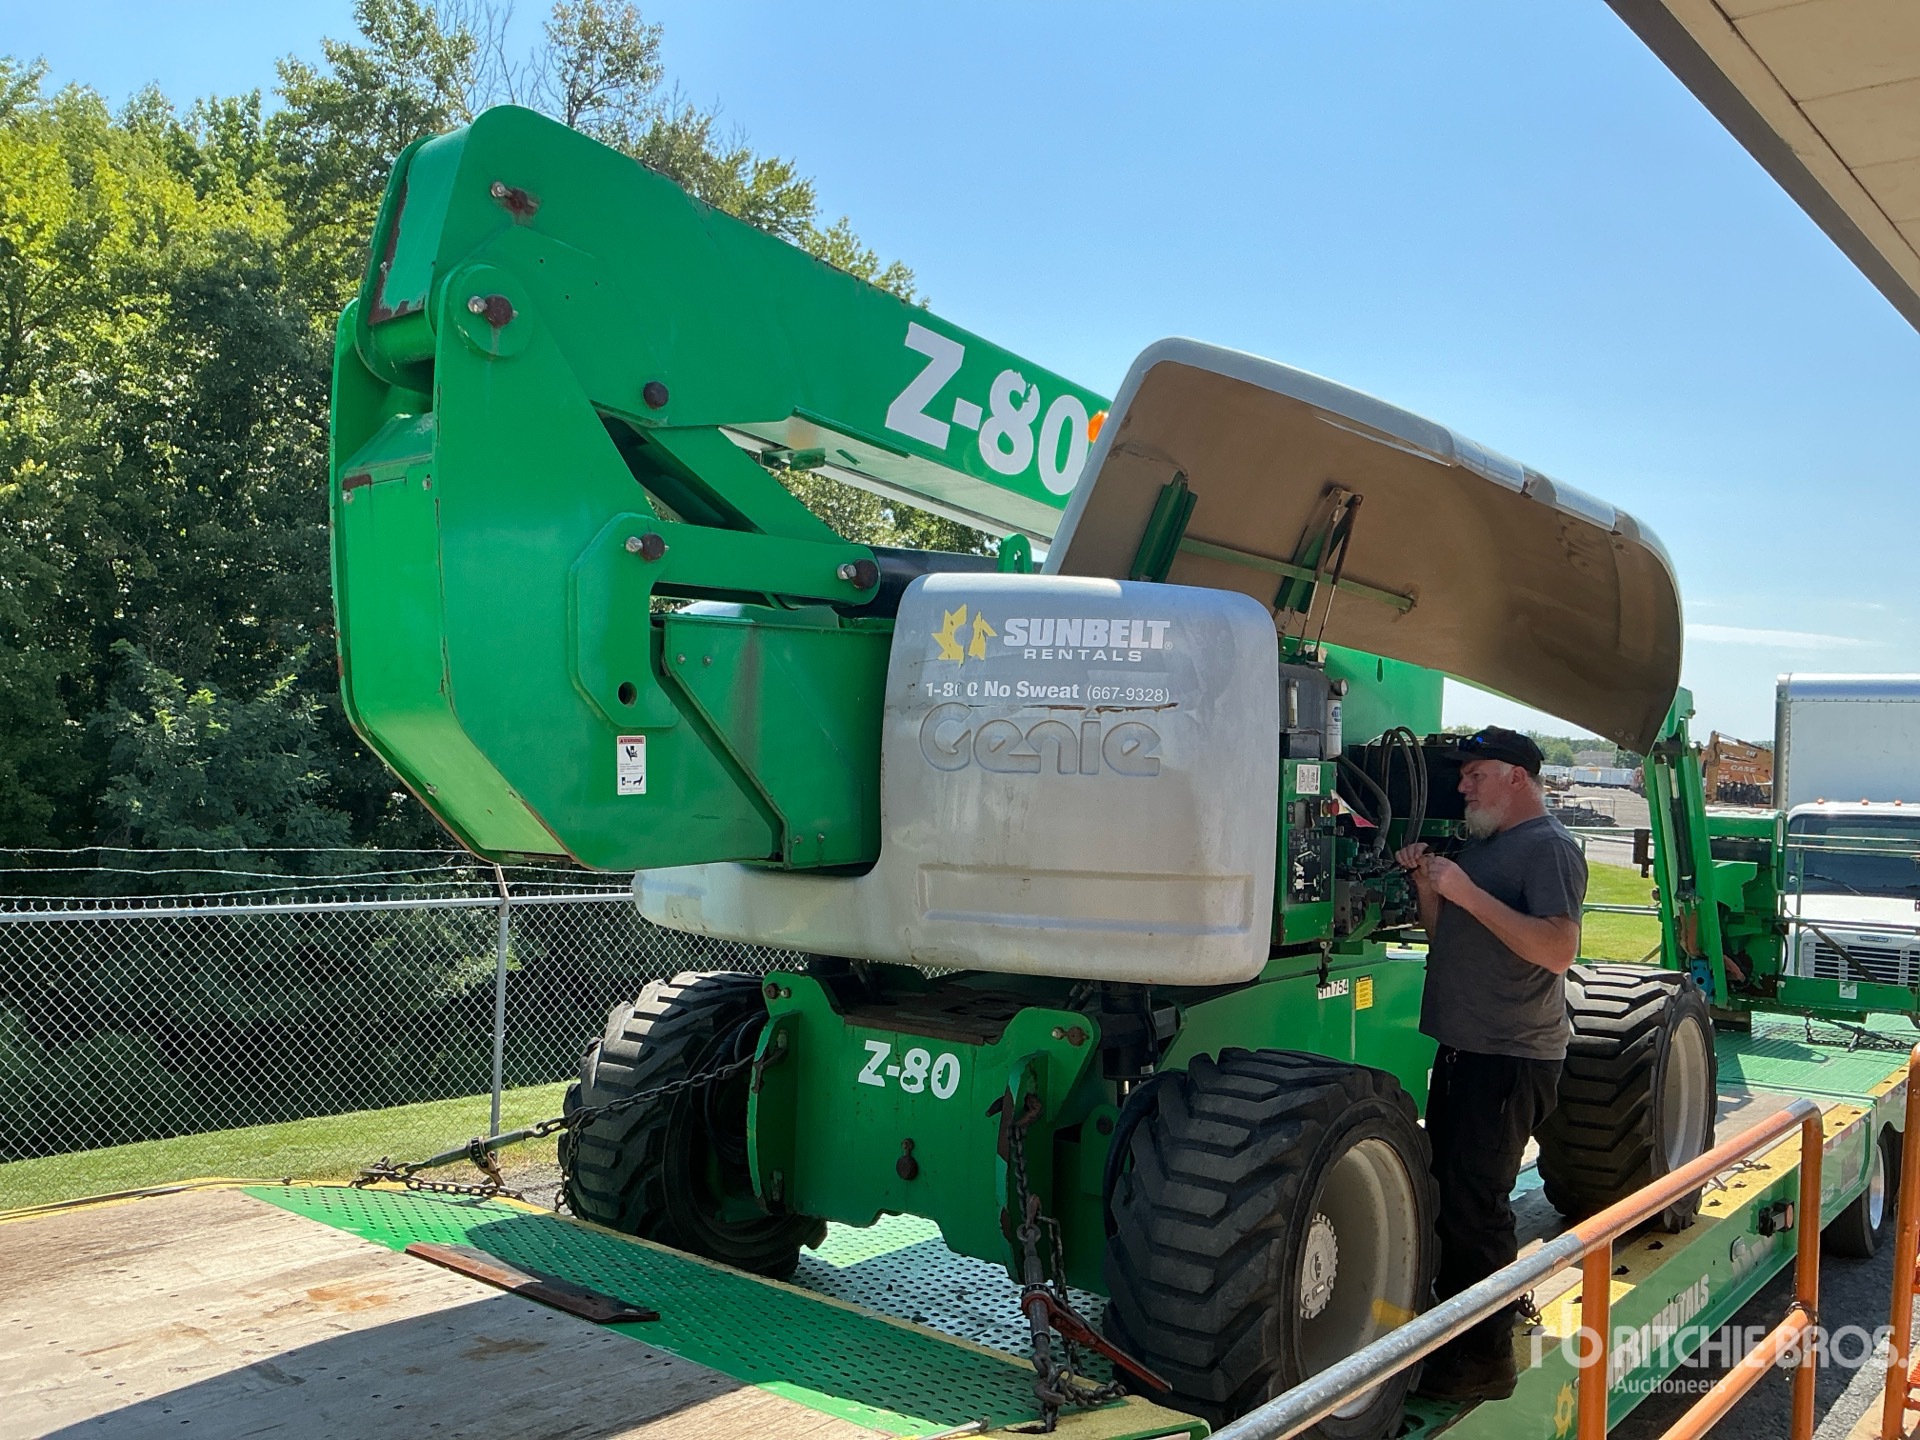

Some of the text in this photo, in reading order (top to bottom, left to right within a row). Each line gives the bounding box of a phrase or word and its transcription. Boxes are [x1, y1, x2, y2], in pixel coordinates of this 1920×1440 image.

[884, 321, 1089, 496] Z-80
[1003, 618, 1171, 649] SUNBELT
[1023, 649, 1143, 662] RENTALS
[984, 681, 1011, 697] No
[1015, 680, 1080, 699] Sweat
[1086, 687, 1170, 703] (667-9328)
[919, 702, 1161, 777] Genie
[858, 1039, 961, 1100] Z-80
